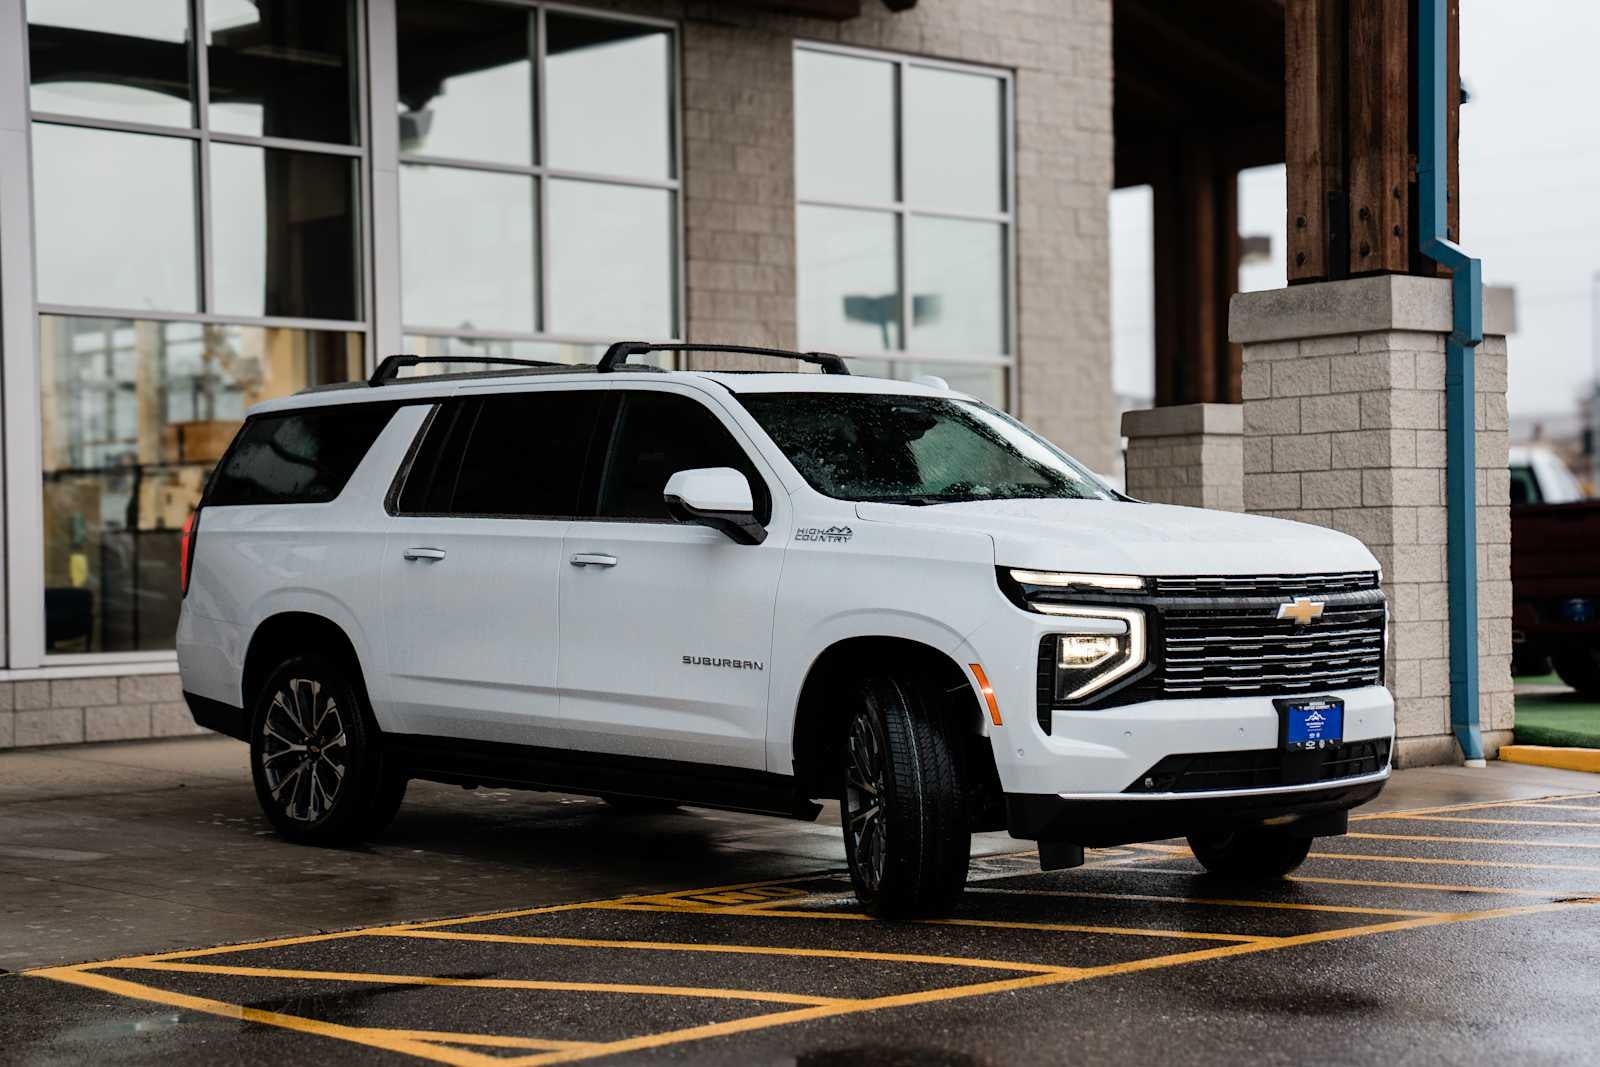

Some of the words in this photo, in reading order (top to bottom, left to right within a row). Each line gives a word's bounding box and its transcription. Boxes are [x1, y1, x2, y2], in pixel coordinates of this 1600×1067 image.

[796, 527, 826, 535] HIGH
[794, 534, 852, 543] COUNTRY
[682, 655, 764, 670] SUBURBAN
